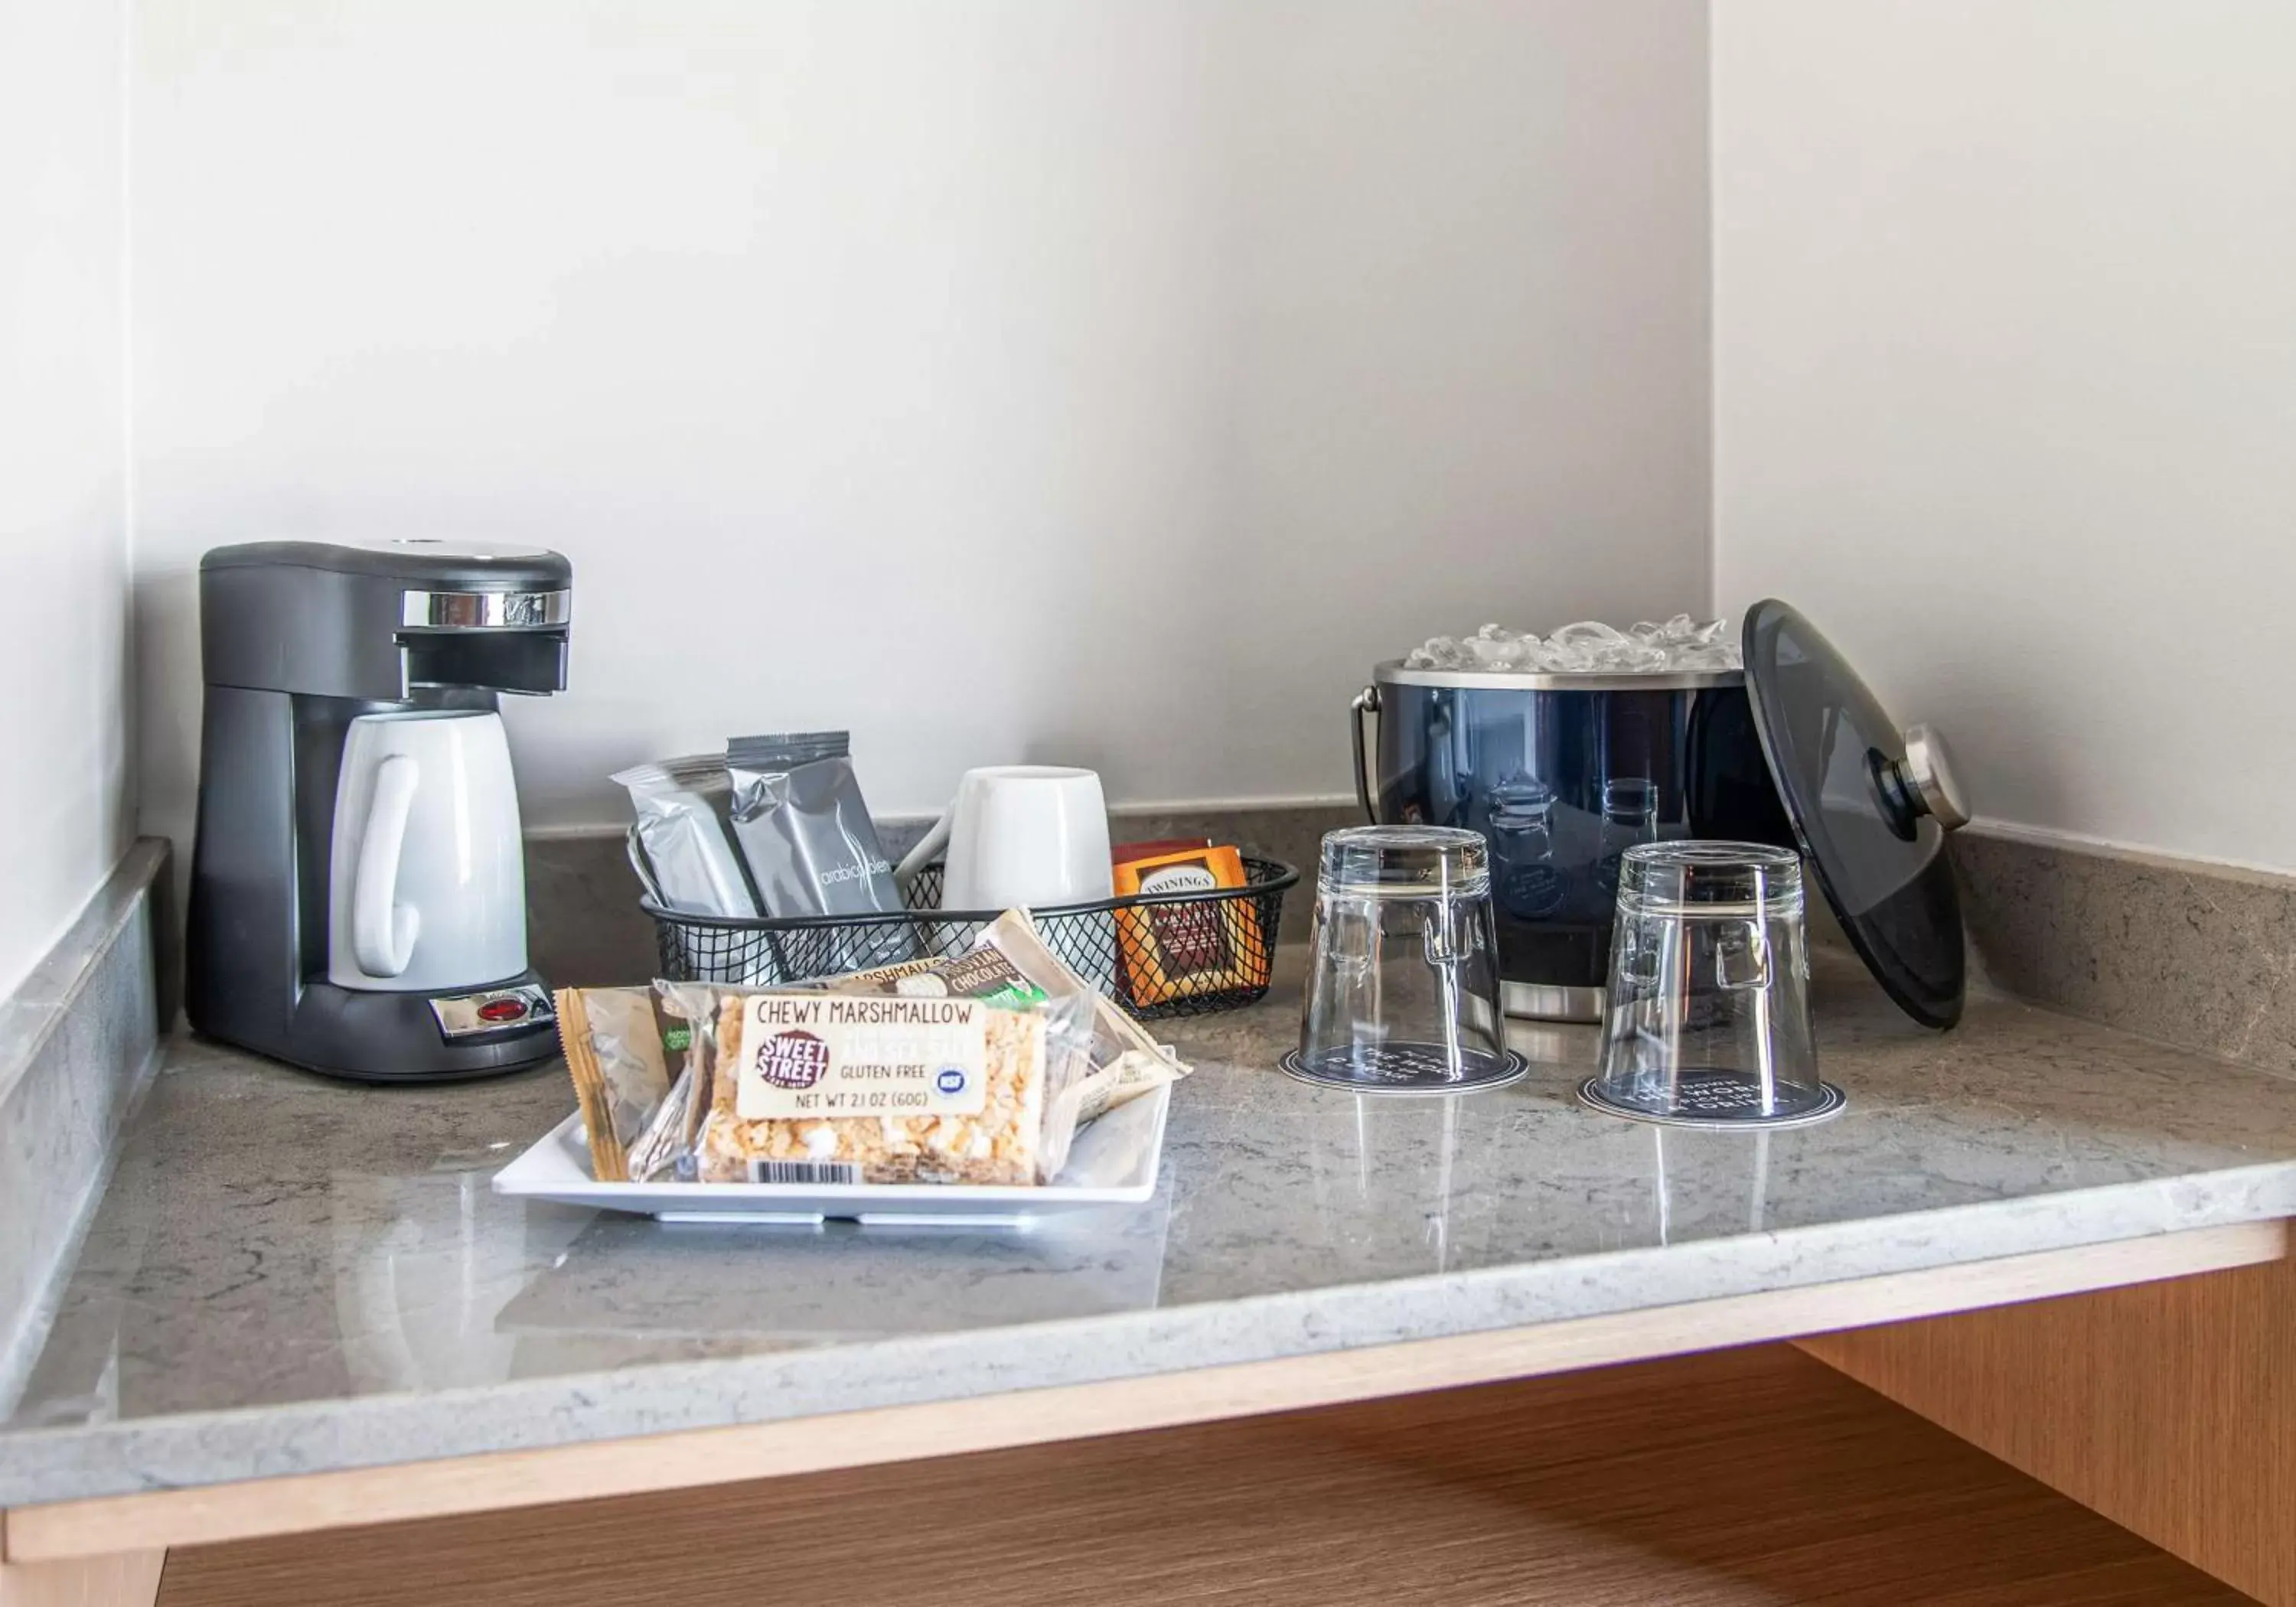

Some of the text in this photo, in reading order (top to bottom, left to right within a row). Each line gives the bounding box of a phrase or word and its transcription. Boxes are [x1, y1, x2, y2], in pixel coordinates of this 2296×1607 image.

[951, 961, 1016, 993] CHOCOLATE
[757, 1000, 973, 1025] CHEWY MARSHMALLOW
[763, 1035, 827, 1062] SWEET
[755, 1054, 827, 1082] STREET
[841, 1064, 926, 1079] GLUTEN FREE
[796, 1094, 819, 1109] NET
[826, 1094, 845, 1108] WT
[870, 1094, 887, 1107] OZ
